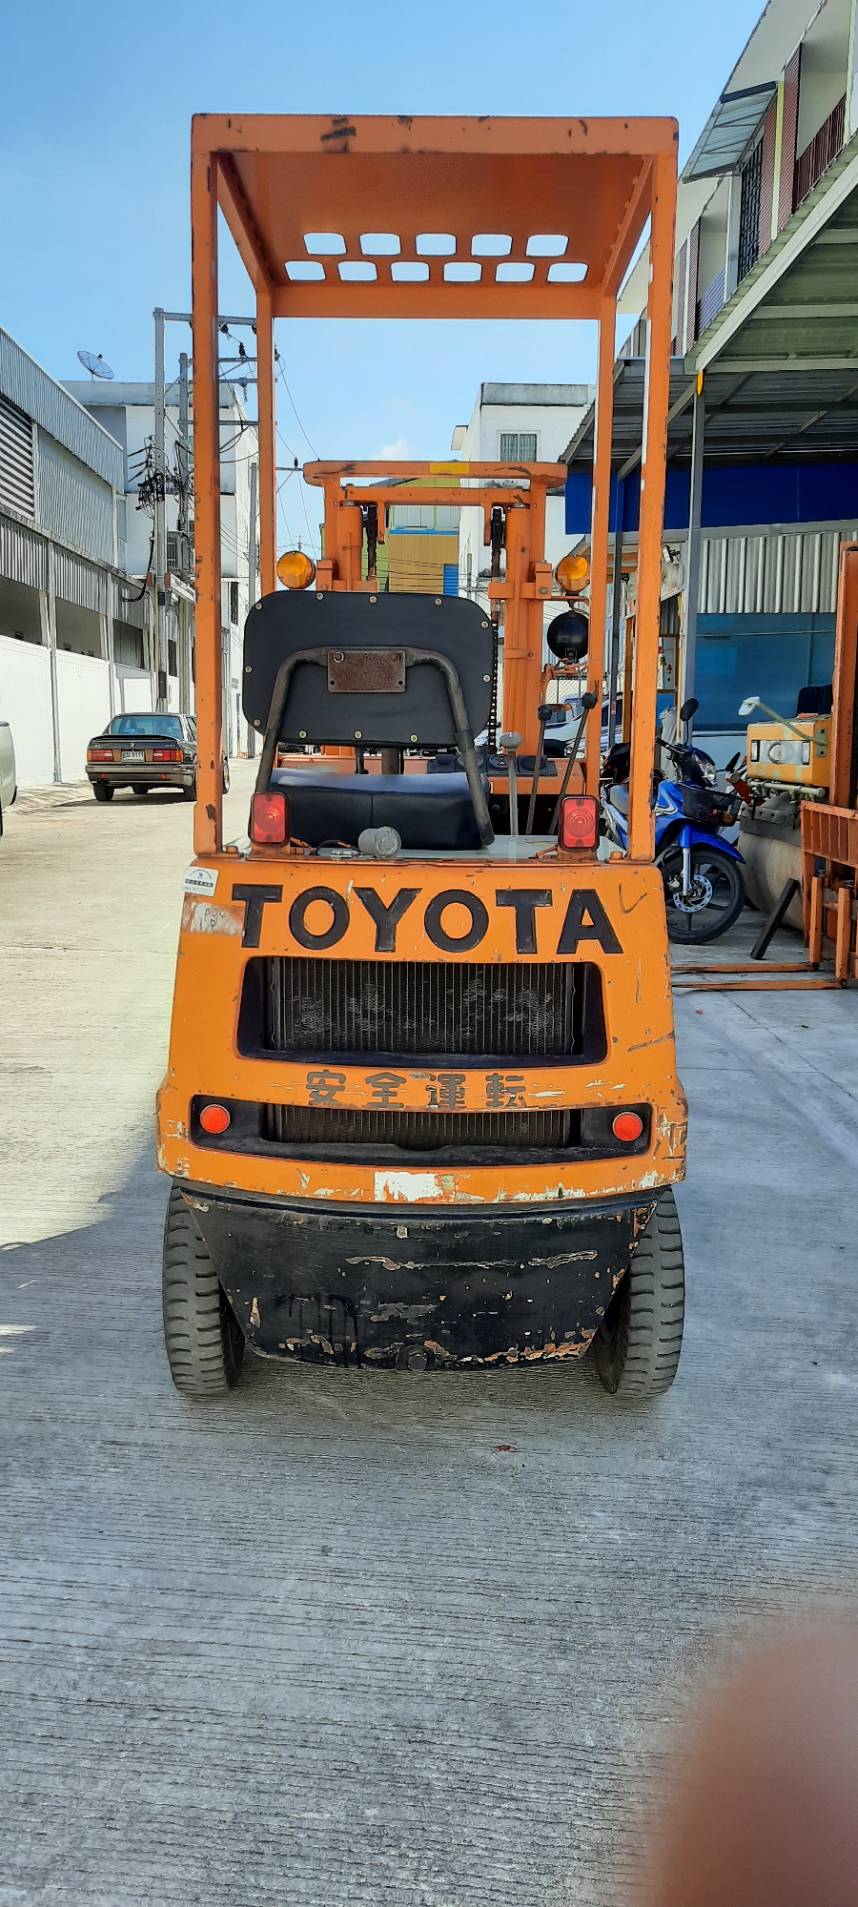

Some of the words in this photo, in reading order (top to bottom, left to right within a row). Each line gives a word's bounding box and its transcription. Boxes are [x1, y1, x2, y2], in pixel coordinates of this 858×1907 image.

[232, 884, 623, 954] TOYOTA
[306, 1069, 529, 1109] 安全運転
